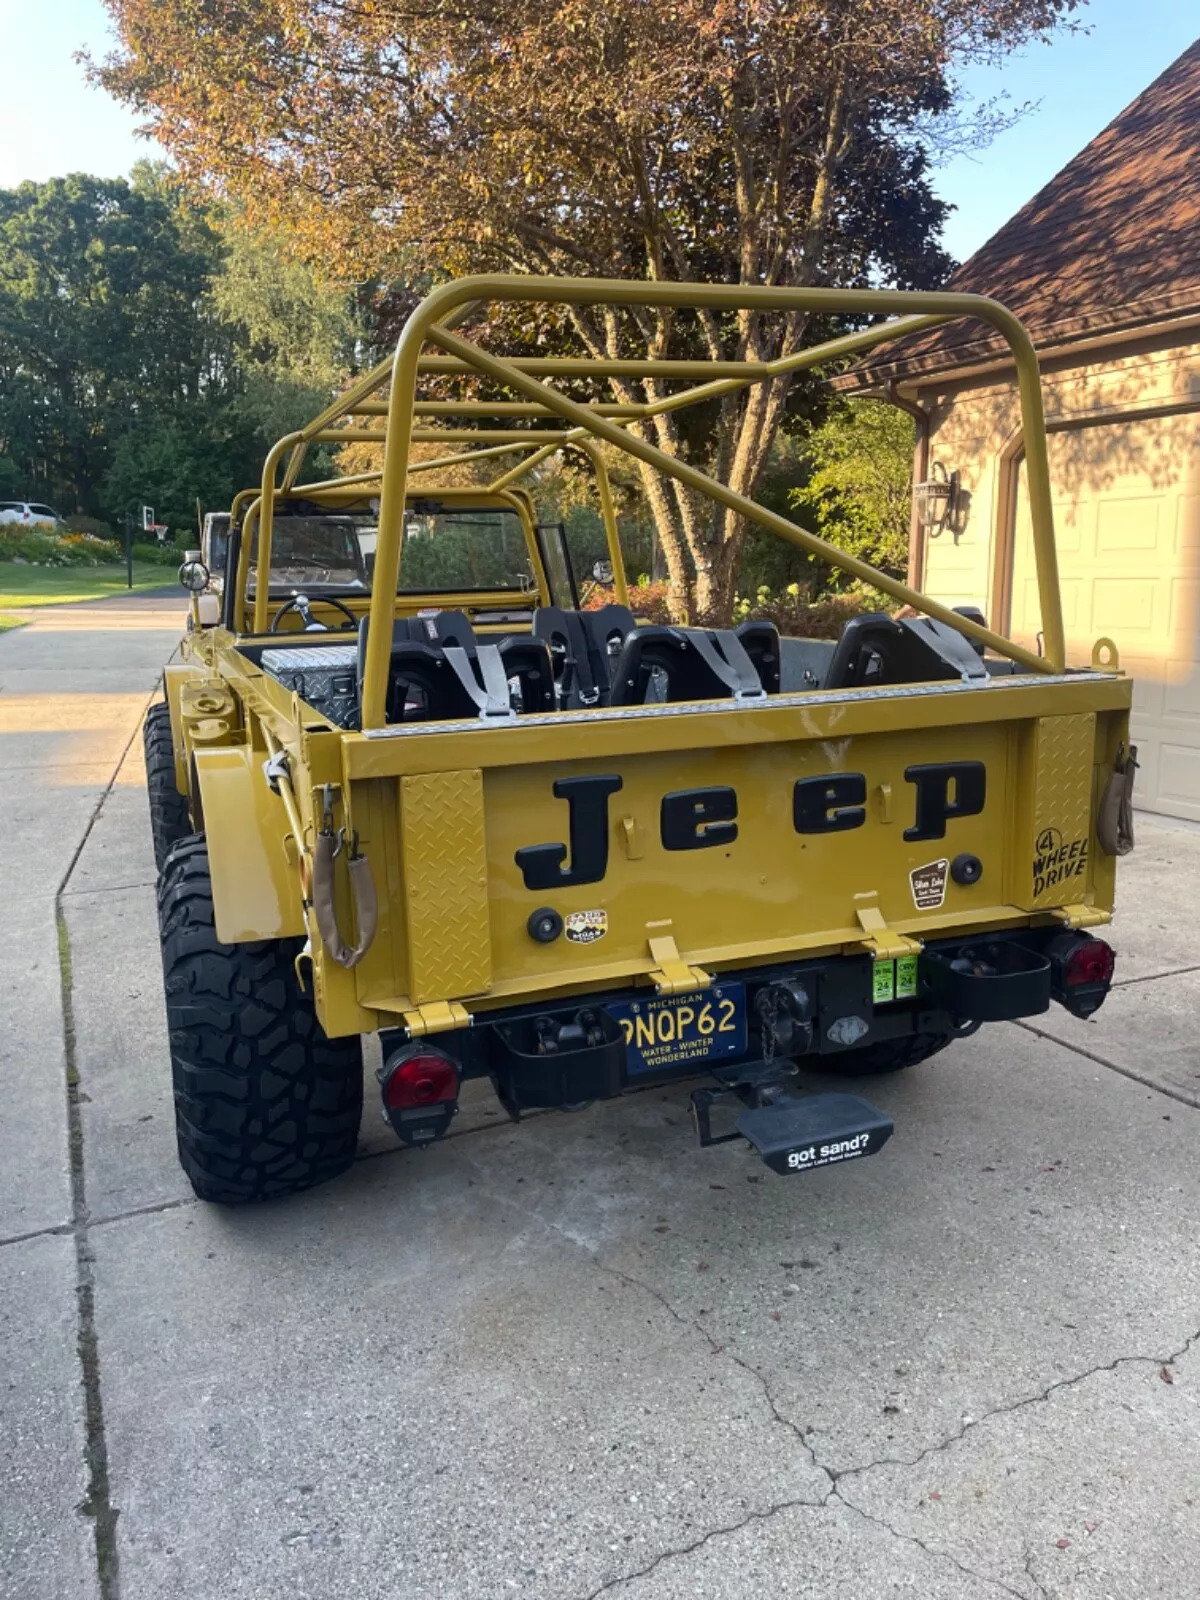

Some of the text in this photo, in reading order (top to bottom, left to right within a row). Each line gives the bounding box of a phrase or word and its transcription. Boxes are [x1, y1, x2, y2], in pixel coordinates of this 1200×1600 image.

[514, 762, 986, 891] Jeep
[1033, 838, 1088, 878] WHEEL
[1033, 859, 1087, 897] DRIVE
[648, 993, 703, 1010] MICHIGAN
[641, 1045, 671, 1058] WATER
[679, 1037, 714, 1050] WINTER
[647, 1048, 709, 1066] WONDERLAND
[788, 1134, 869, 1168] got sand?
